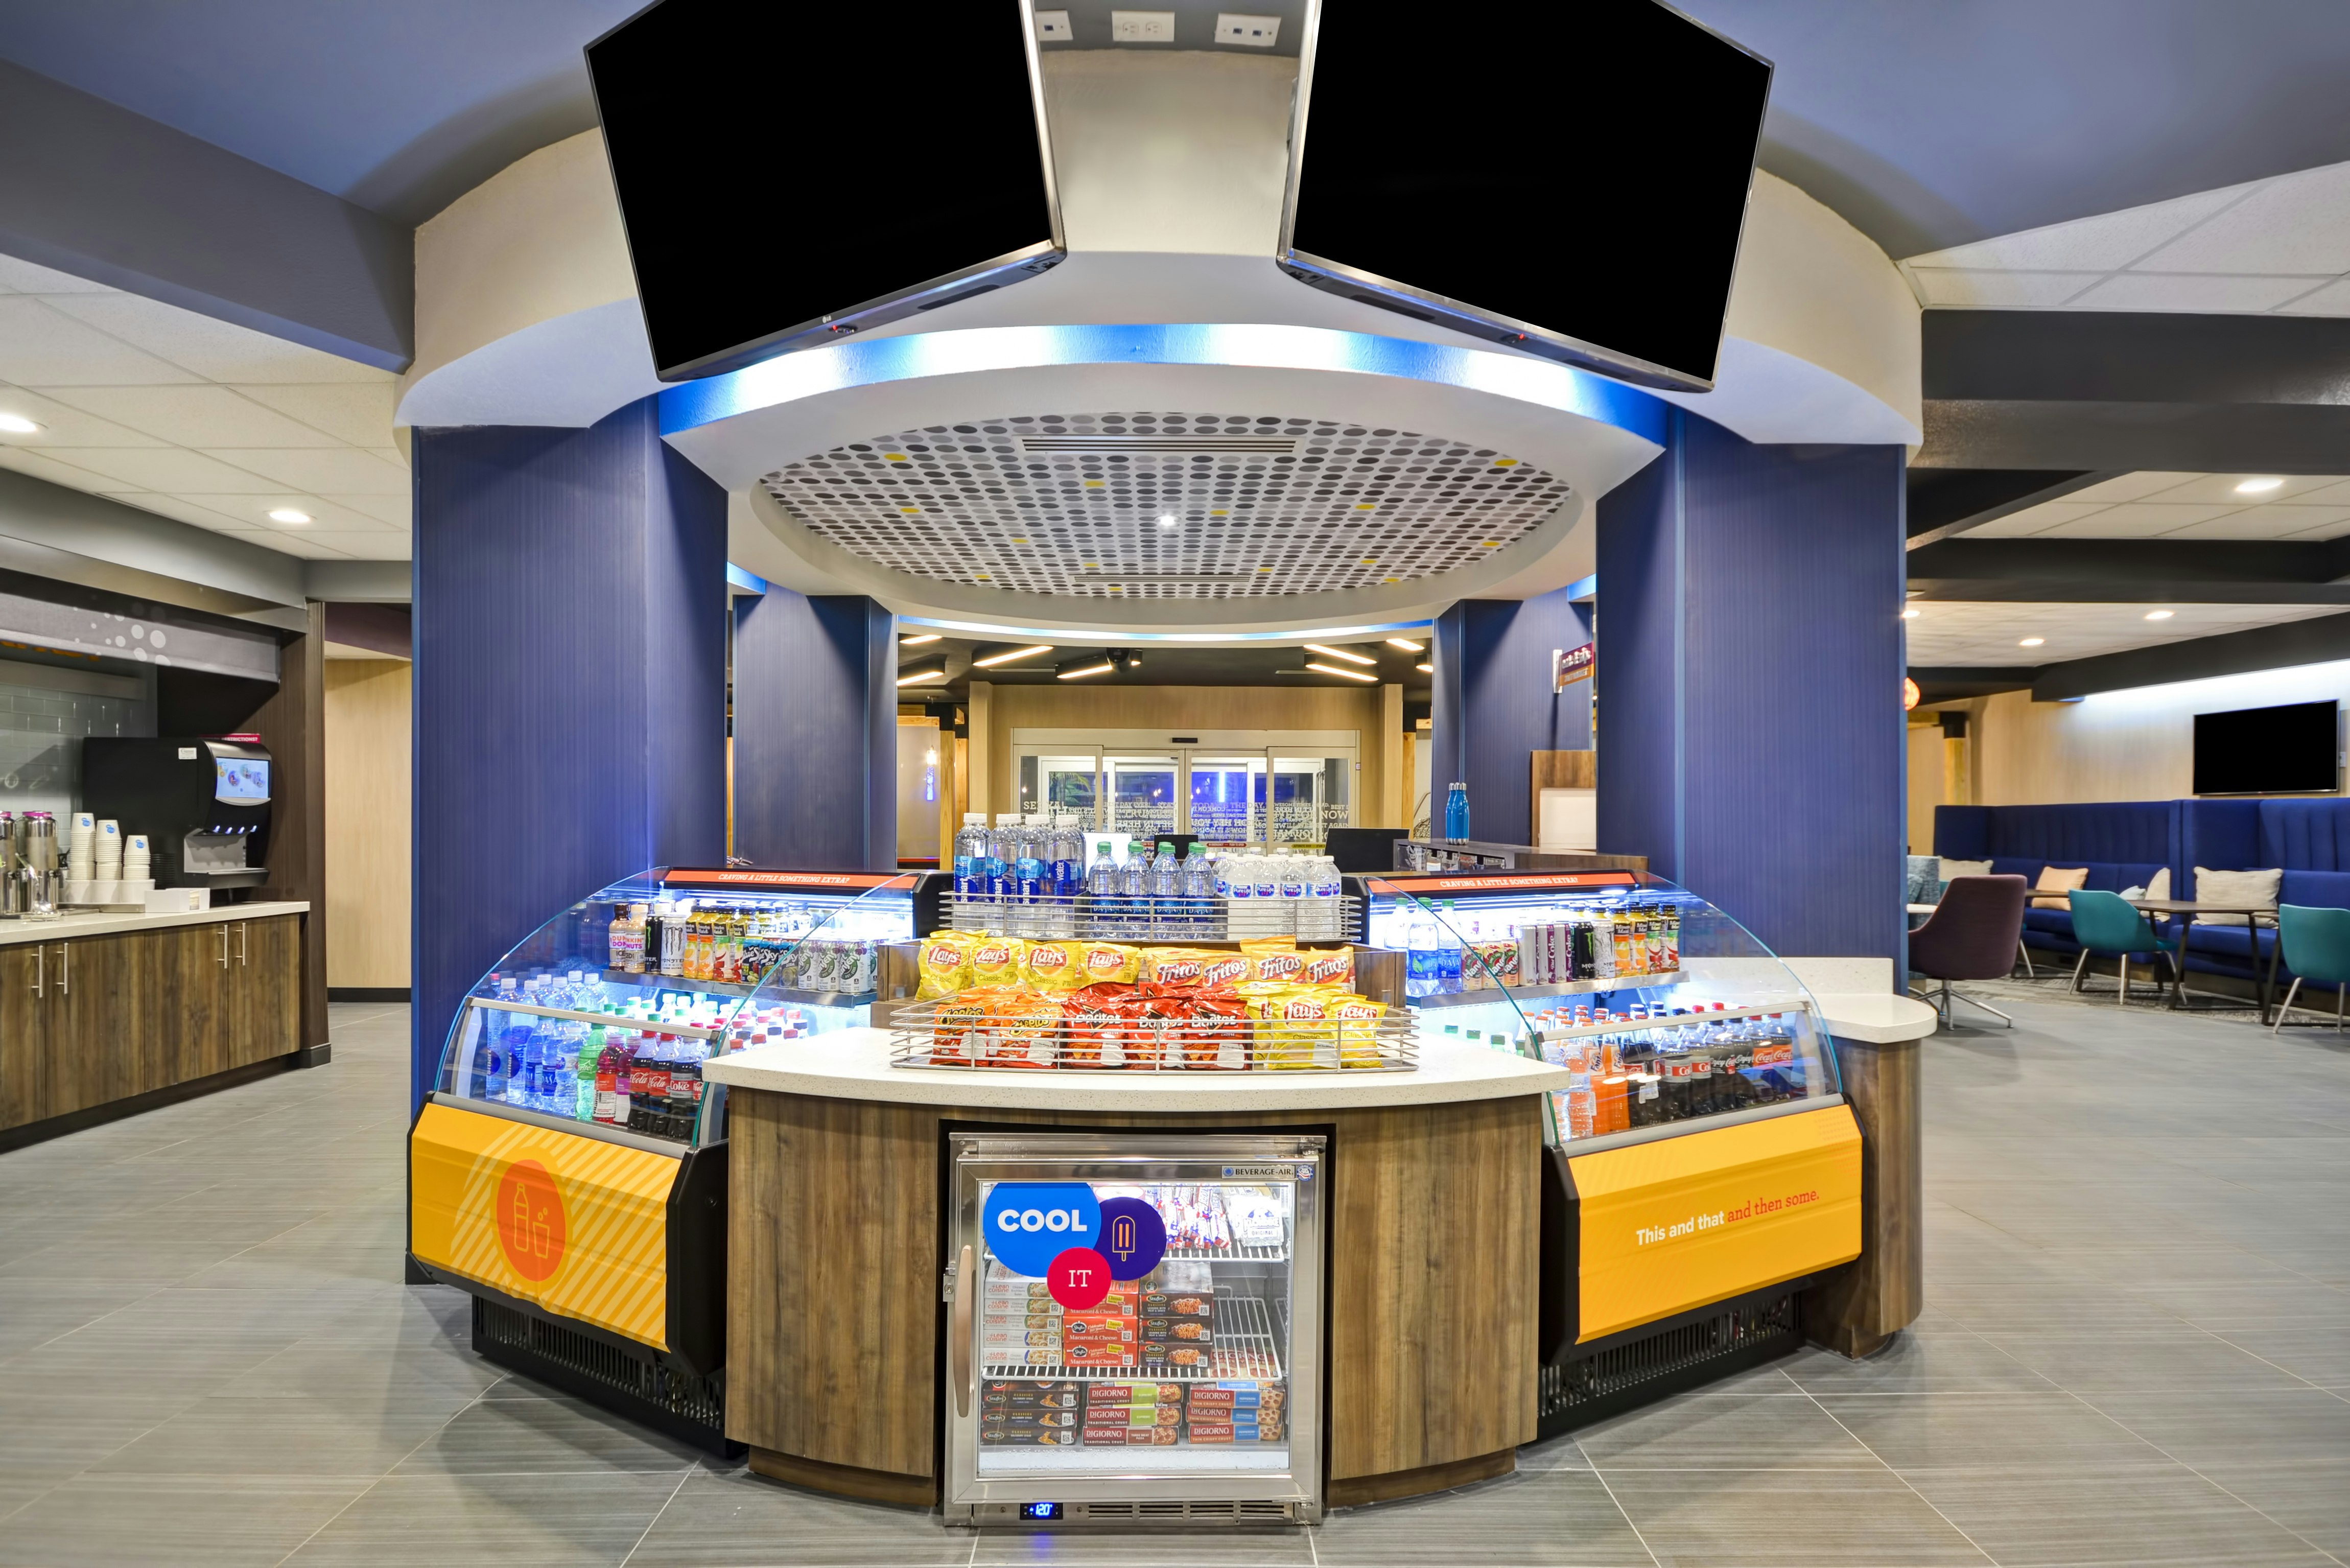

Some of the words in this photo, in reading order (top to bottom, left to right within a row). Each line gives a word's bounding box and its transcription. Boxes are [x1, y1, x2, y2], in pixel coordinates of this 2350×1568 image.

[1322, 810, 1349, 819] NOW
[1156, 962, 1201, 985] Fritos
[1203, 959, 1247, 987] Fritos
[1258, 956, 1301, 980] Fritos
[1307, 957, 1348, 984] Fritos
[930, 974, 952, 983] Classic
[978, 974, 1002, 982] Classic
[1034, 976, 1058, 985] Classic
[1074, 1013, 1122, 1025] Doritos
[1190, 1014, 1237, 1028] Doritos
[1344, 1031, 1374, 1039] Classic
[670, 1080, 690, 1091] Coke
[997, 1209, 1087, 1232] COOL
[1636, 1225, 1666, 1246] This
[1669, 1217, 1694, 1238] and
[1698, 1210, 1724, 1230] that
[1728, 1201, 1751, 1223] and
[1754, 1197, 1782, 1215] then
[1785, 1190, 1820, 1208] some.
[1068, 1270, 1092, 1287] IT
